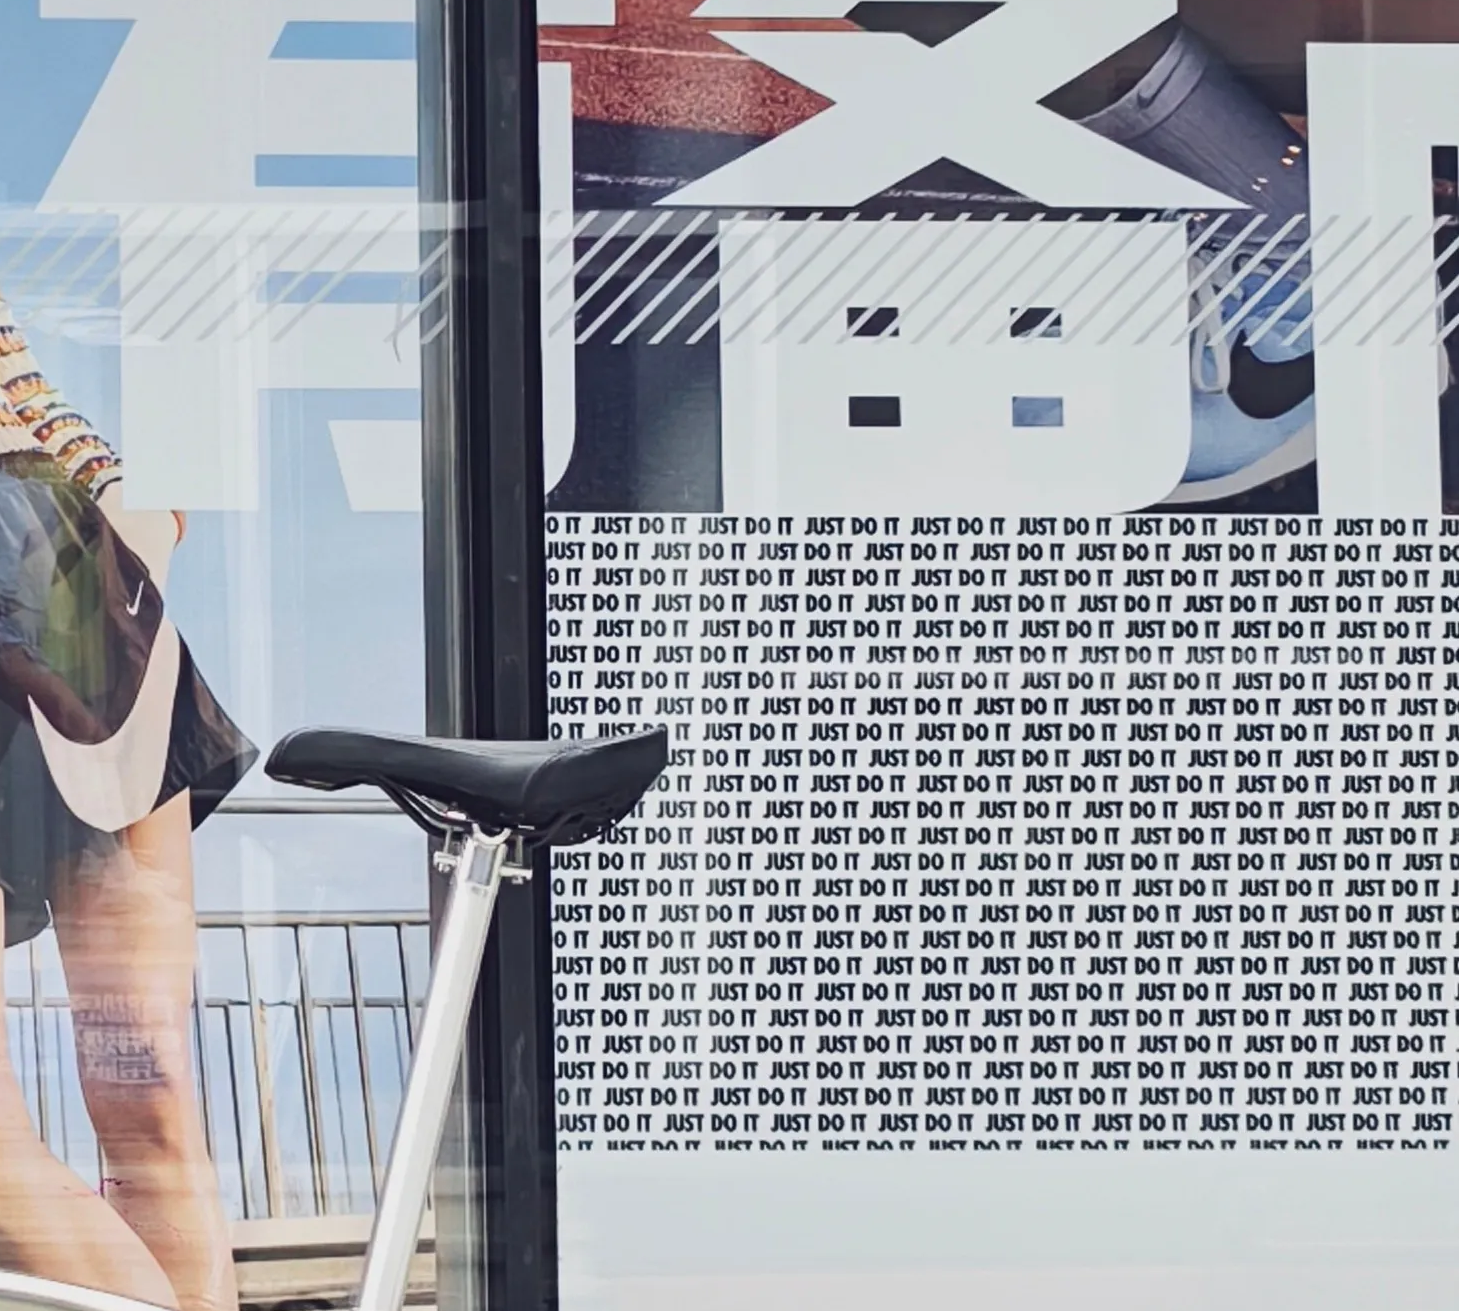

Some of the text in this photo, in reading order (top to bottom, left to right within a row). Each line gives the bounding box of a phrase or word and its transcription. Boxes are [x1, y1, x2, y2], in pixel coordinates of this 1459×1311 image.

[566, 516, 581, 534] IT
[591, 516, 632, 534] JUST
[639, 516, 664, 534] DO
[672, 516, 687, 534] IT
[699, 516, 739, 535] JUST
[745, 516, 771, 535] DO
[778, 516, 794, 535] IT
[804, 516, 845, 535] JUST
[851, 516, 877, 535] DO
[884, 516, 900, 535] IT
[911, 516, 951, 536] JUST
[957, 516, 983, 535] DO
[990, 516, 1005, 535] IT
[1017, 516, 1057, 536] JUST
[1064, 516, 1089, 536] DO
[1096, 516, 1112, 536] IT
[1123, 517, 1163, 536] JUST
[1169, 517, 1196, 536] DO
[1202, 517, 1217, 536] IT
[1228, 517, 1269, 536] JUST
[1275, 517, 1301, 536] DO
[1308, 517, 1323, 536] IT
[1334, 518, 1374, 536] JUST
[1380, 518, 1406, 536] DO
[1413, 518, 1428, 536] IT
[592, 541, 618, 560] DO
[625, 541, 640, 560] IT
[651, 542, 691, 560] JUST
[699, 542, 724, 560] DO
[731, 542, 746, 561] IT
[758, 542, 798, 560] JUST
[804, 542, 831, 560] DO
[837, 542, 853, 561] IT
[864, 542, 904, 561] JUST
[911, 542, 937, 561] DO
[943, 542, 959, 560] IT
[970, 542, 1011, 561] JUST
[1017, 542, 1043, 561] DO
[1050, 542, 1065, 561] IT
[1076, 542, 1117, 561] JUST
[1123, 542, 1149, 561] DO
[1155, 542, 1171, 561] IT
[1182, 542, 1222, 562] JUST
[1229, 543, 1255, 561] DO
[1262, 543, 1277, 562] IT
[1287, 543, 1328, 562] JUST
[1334, 543, 1360, 562] DO
[1367, 543, 1381, 562] IT
[1393, 543, 1433, 562] JUST
[594, 696, 621, 715] DO
[627, 696, 643, 715] IT
[655, 696, 694, 715] JUST
[702, 696, 727, 715] DO
[734, 696, 750, 715] IT
[760, 696, 801, 715] JUST
[808, 696, 834, 715] DO
[840, 696, 856, 715] IT
[867, 696, 908, 715] JUST
[915, 696, 941, 715] DO
[947, 696, 963, 715] IT
[974, 696, 1015, 715] JUST
[1021, 696, 1047, 715] DO
[1054, 697, 1069, 715] IT
[1080, 697, 1121, 715] JUST
[1127, 697, 1153, 715] DO
[1159, 697, 1176, 715] IT
[1186, 697, 1227, 716] JUST
[1233, 697, 1259, 715] DO
[1266, 697, 1281, 716] IT
[1292, 697, 1333, 716] JUST
[1339, 697, 1365, 716] DO
[1371, 697, 1387, 716] IT
[1398, 697, 1438, 716] JUST
[599, 903, 625, 923] DO
[632, 904, 647, 922] IT
[659, 904, 699, 922] JUST
[706, 904, 732, 923] DO
[739, 904, 754, 923] IT
[766, 904, 807, 923] JUST
[812, 904, 839, 923] DO
[846, 904, 861, 923] IT
[873, 904, 913, 923] JUST
[919, 904, 946, 923] DO
[952, 904, 968, 923] IT
[979, 904, 1019, 923] JUST
[1026, 904, 1053, 923] DO
[1059, 904, 1075, 923] IT
[1086, 904, 1126, 923] JUST
[1133, 904, 1159, 923] DO
[1166, 904, 1181, 922] IT
[1192, 904, 1233, 923] JUST
[1239, 904, 1265, 923] DO
[1272, 904, 1288, 923] IT
[1299, 904, 1339, 923] JUST
[1346, 904, 1372, 923] DO
[1378, 904, 1394, 923] IT
[1405, 904, 1445, 923] JUST
[603, 1113, 630, 1132] DO
[637, 1113, 652, 1132] IT
[663, 1113, 704, 1132] JUST
[711, 1113, 737, 1132] DO
[744, 1113, 760, 1132] IT
[771, 1113, 811, 1132] JUST
[818, 1113, 845, 1132] DO
[851, 1113, 867, 1132] IT
[878, 1113, 919, 1132] JUST
[925, 1113, 952, 1132] DO
[958, 1113, 974, 1131] IT
[986, 1113, 1026, 1132] JUST
[1032, 1113, 1059, 1131] DO
[1065, 1113, 1081, 1131] IT
[1092, 1113, 1133, 1131] JUST
[1139, 1113, 1166, 1131] DO
[1172, 1113, 1188, 1131] IT
[1200, 1112, 1240, 1131] JUST
[1246, 1112, 1273, 1131] DO
[1279, 1112, 1295, 1131] IT
[1306, 1112, 1346, 1131] JUST
[1353, 1112, 1379, 1131] DO
[1385, 1113, 1401, 1131] IT
[1412, 1112, 1453, 1131] JUST
